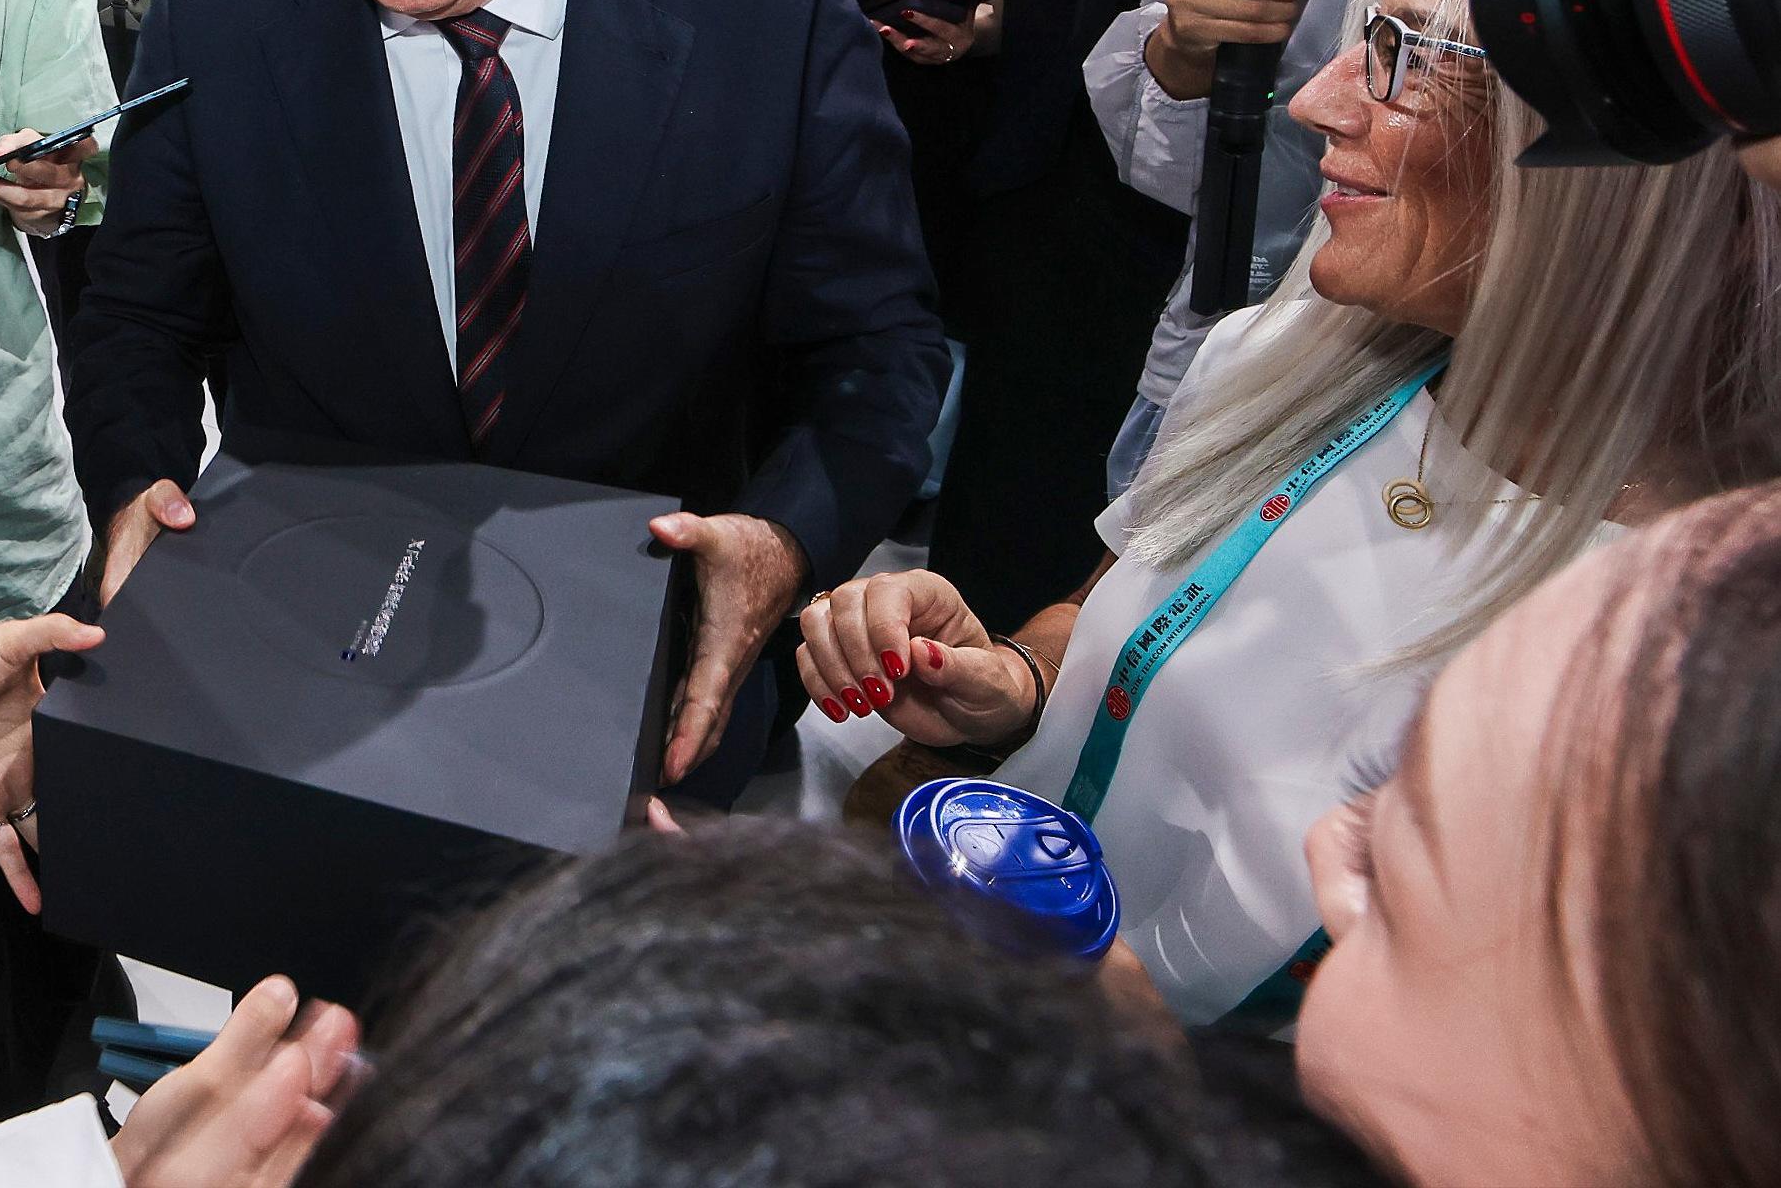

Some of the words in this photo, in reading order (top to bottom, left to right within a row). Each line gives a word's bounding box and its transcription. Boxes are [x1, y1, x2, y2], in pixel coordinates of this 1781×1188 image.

[1118, 582, 1205, 688] 中信國際電訊
[1141, 642, 1169, 675] TELECOM
[1167, 592, 1212, 646] INTERNATIONAL
